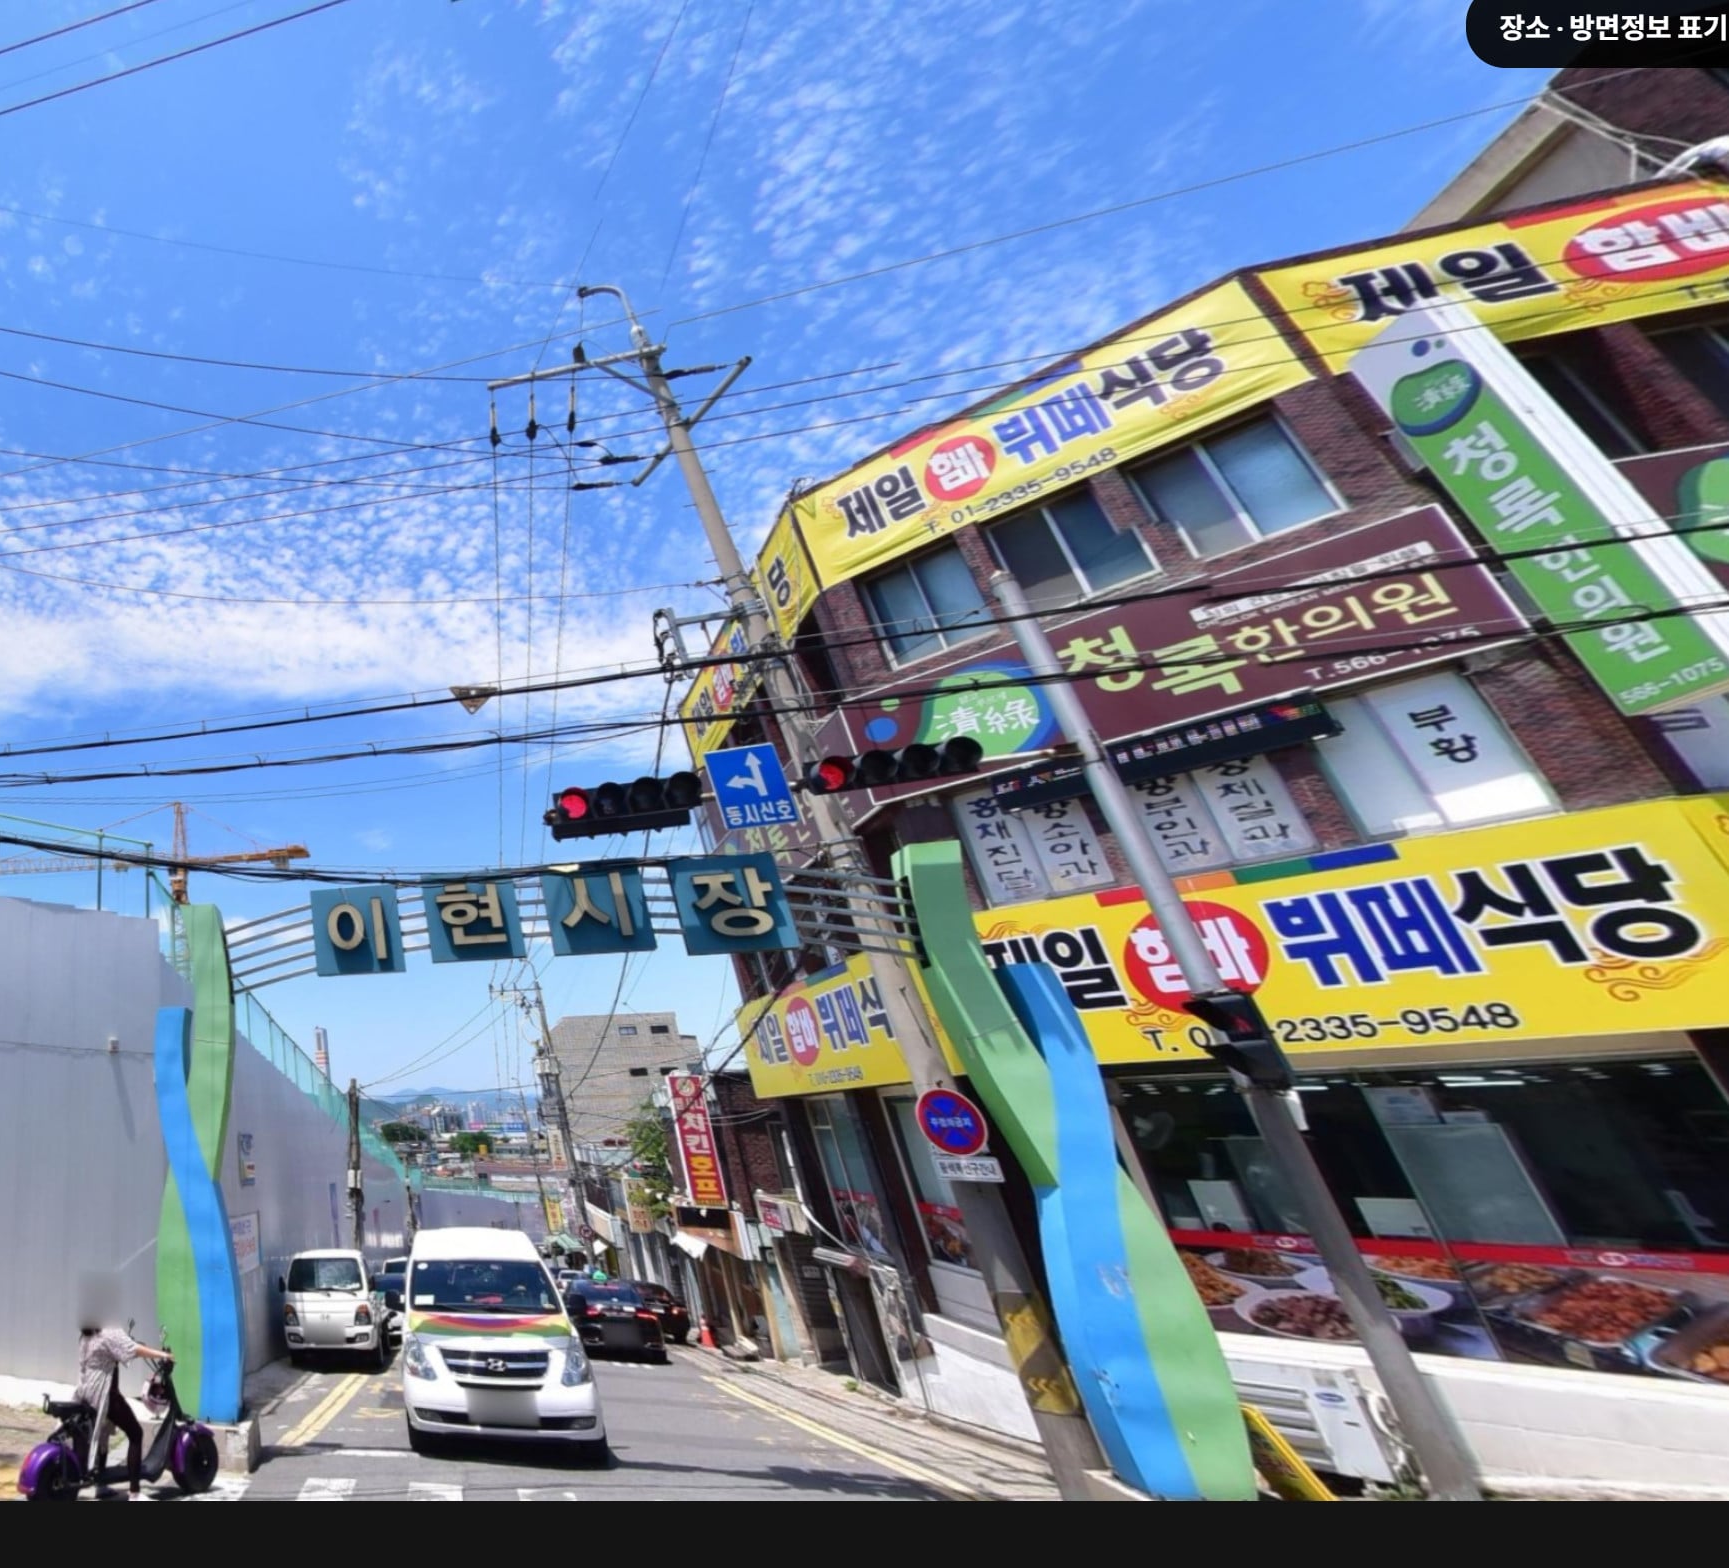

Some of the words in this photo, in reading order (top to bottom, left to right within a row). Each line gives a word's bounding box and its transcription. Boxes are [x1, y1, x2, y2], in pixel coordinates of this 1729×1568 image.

[1337, 242, 1560, 322] 제일
[836, 465, 927, 540] 제일
[927, 441, 991, 492] 함바
[991, 327, 1226, 464] 뷔페식당
[1443, 420, 1670, 665] 청록한의원
[1055, 572, 1460, 696] 청록한의원
[1618, 657, 1727, 705] 566-1075
[725, 798, 796, 827] 동시신호
[326, 866, 776, 960] 이현시장
[1130, 915, 1261, 993] 함바
[1264, 846, 1701, 987] 뷔페식당
[754, 1012, 790, 1065] 제일
[814, 974, 896, 1051] 뷔페식
[682, 1111, 722, 1199] 치킨호프
